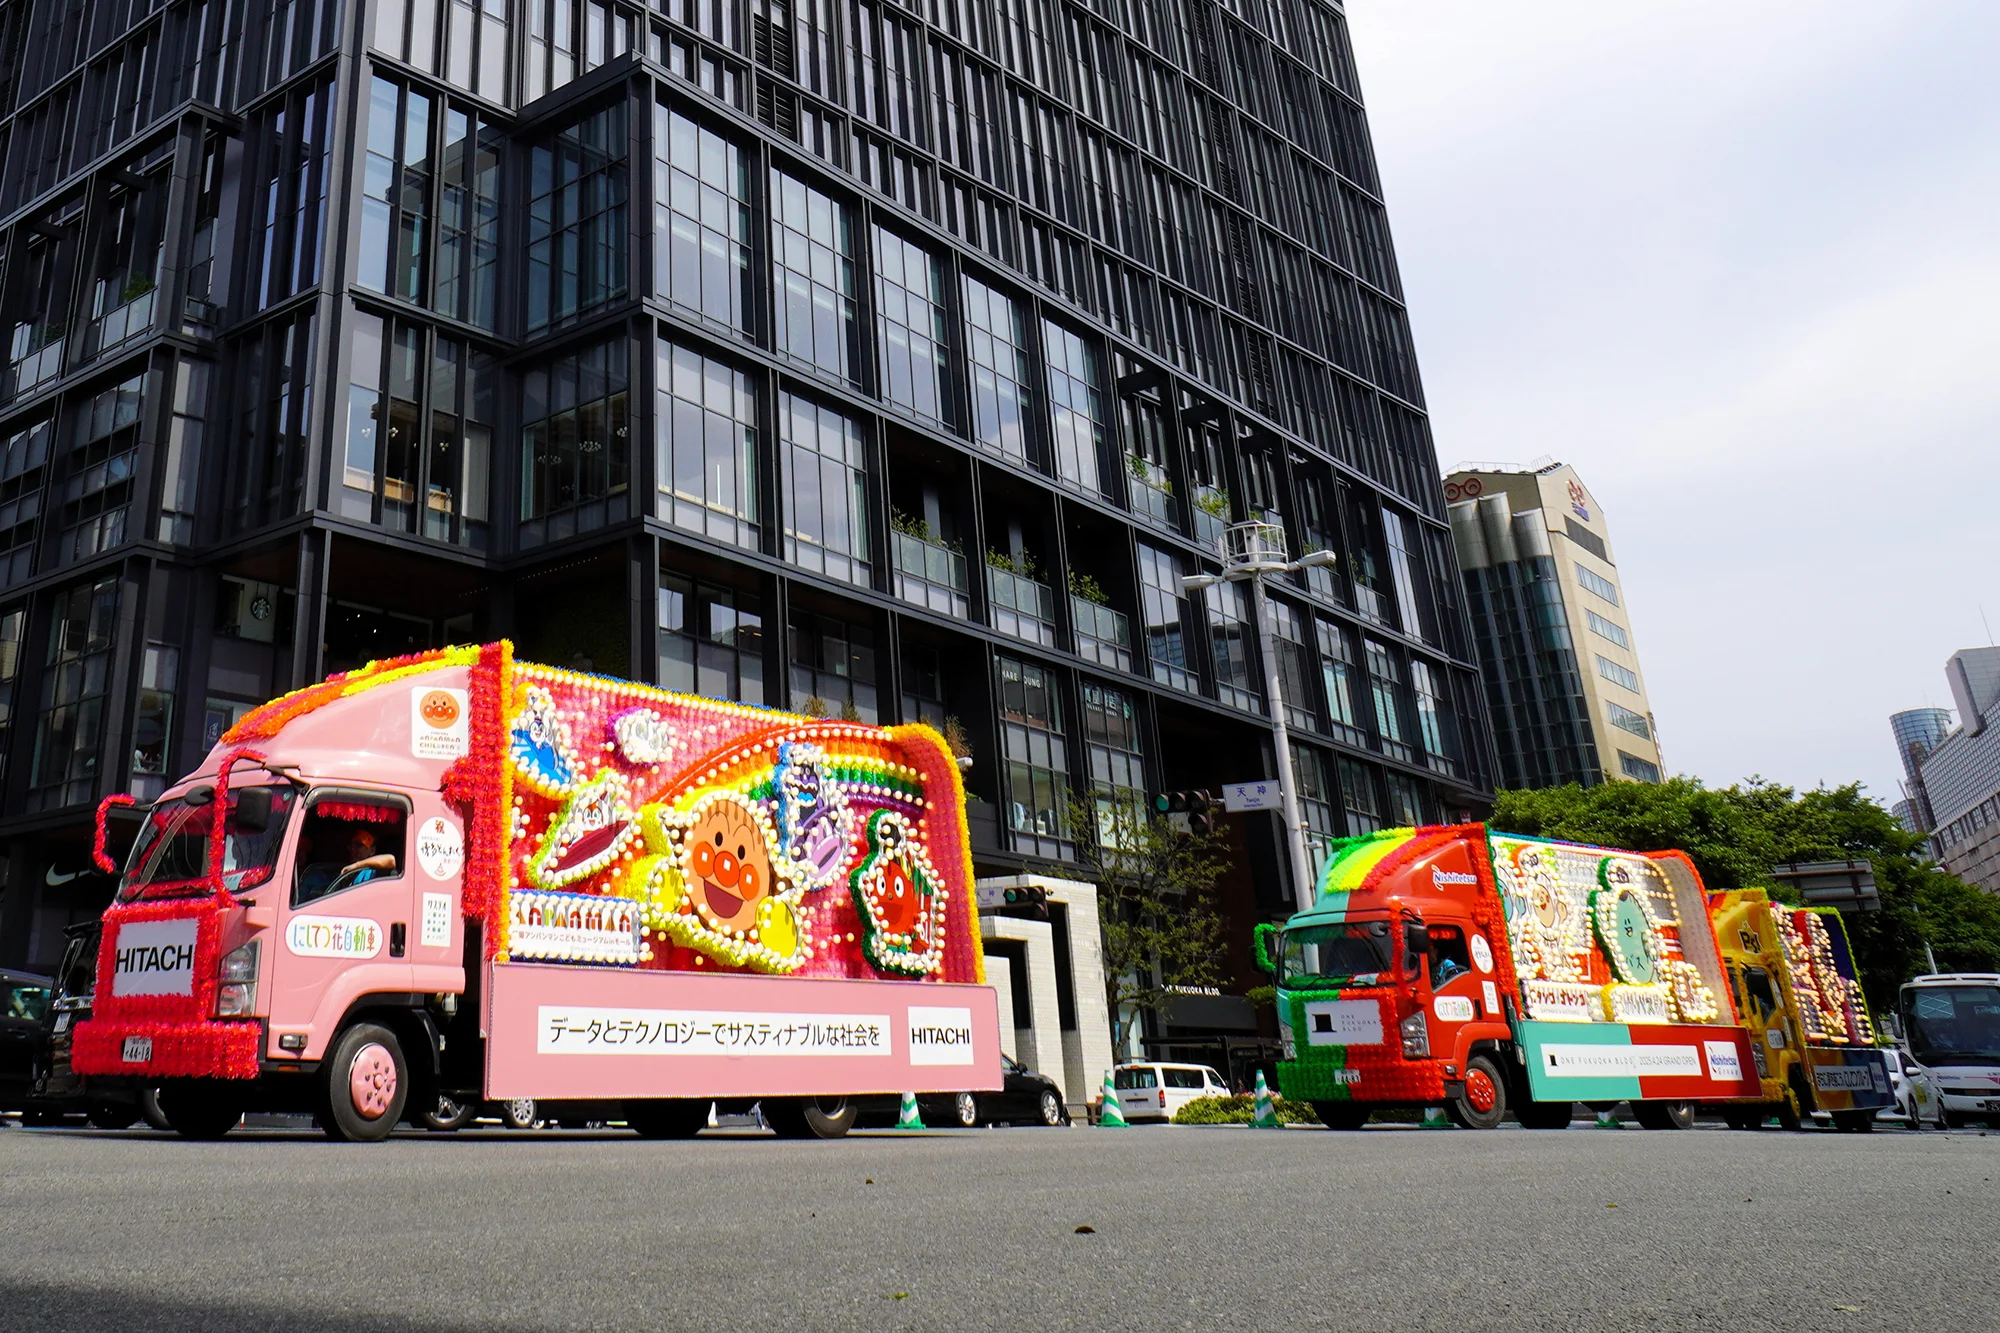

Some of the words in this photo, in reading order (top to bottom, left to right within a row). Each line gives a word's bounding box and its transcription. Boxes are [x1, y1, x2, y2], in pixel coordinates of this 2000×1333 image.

[1001, 669, 1018, 682] HARE
[1236, 784, 1267, 797] 天神
[435, 820, 444, 834] 祝
[1433, 871, 1477, 884] Nishitetsu
[293, 923, 375, 952] にしてつ花自動車
[512, 929, 631, 947] 岡アンパンマンこどもミュージアムinモール
[115, 944, 194, 974] HITACH
[550, 1017, 880, 1048] データとテクノロジーでサスティナブルな社会を
[911, 1028, 971, 1046] HITACHI
[1561, 1057, 1575, 1065] ONE
[1579, 1057, 1613, 1065] FUKUOKA
[1681, 1056, 1697, 1067] OPEN
[1710, 1054, 1737, 1067] Nishitetsu
[1717, 1066, 1739, 1076] Group
